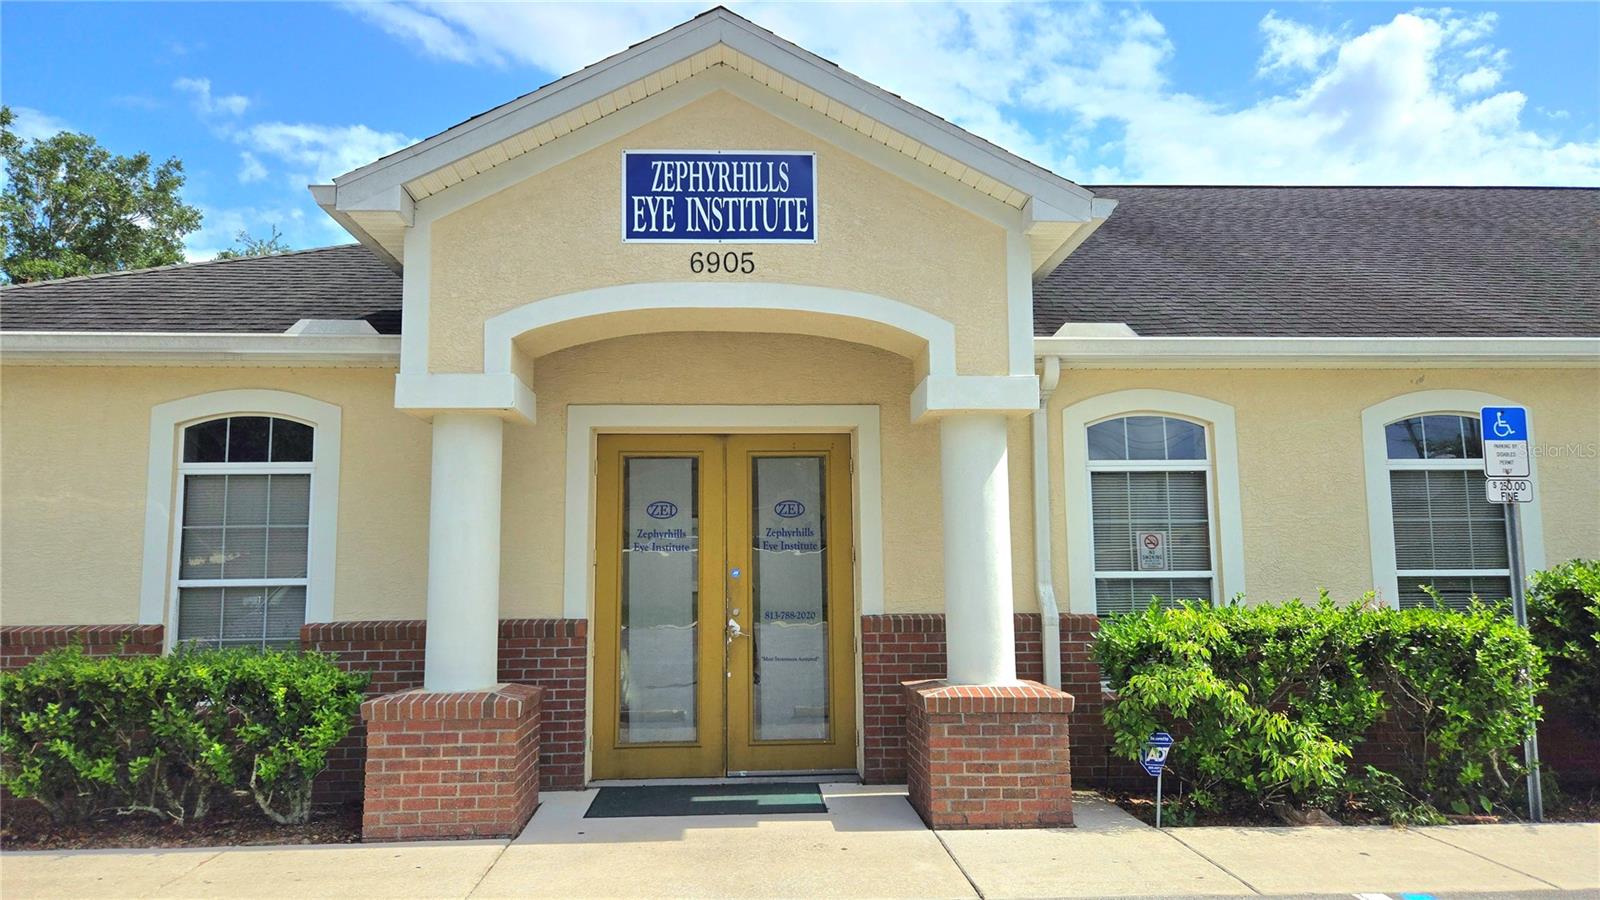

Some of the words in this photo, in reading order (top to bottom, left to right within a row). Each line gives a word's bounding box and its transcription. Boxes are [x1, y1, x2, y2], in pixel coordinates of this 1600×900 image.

[651, 161, 790, 193] ZEPHYRHILLS
[632, 195, 676, 232] EYE
[685, 197, 809, 232] INSTITUTE
[690, 252, 755, 274] 6905
[1500, 481, 1526, 491] 250.00
[1501, 492, 1518, 501] FINE
[650, 504, 676, 516] ZEI
[778, 504, 802, 516] ZEI
[637, 529, 686, 540] Zephyrhills
[766, 527, 814, 539] Zephyrhills
[633, 542, 649, 552] Eye
[652, 542, 690, 552] Institute
[762, 541, 778, 551] Eye
[780, 541, 818, 551] Institute
[764, 611, 816, 620] 813-788-2020
